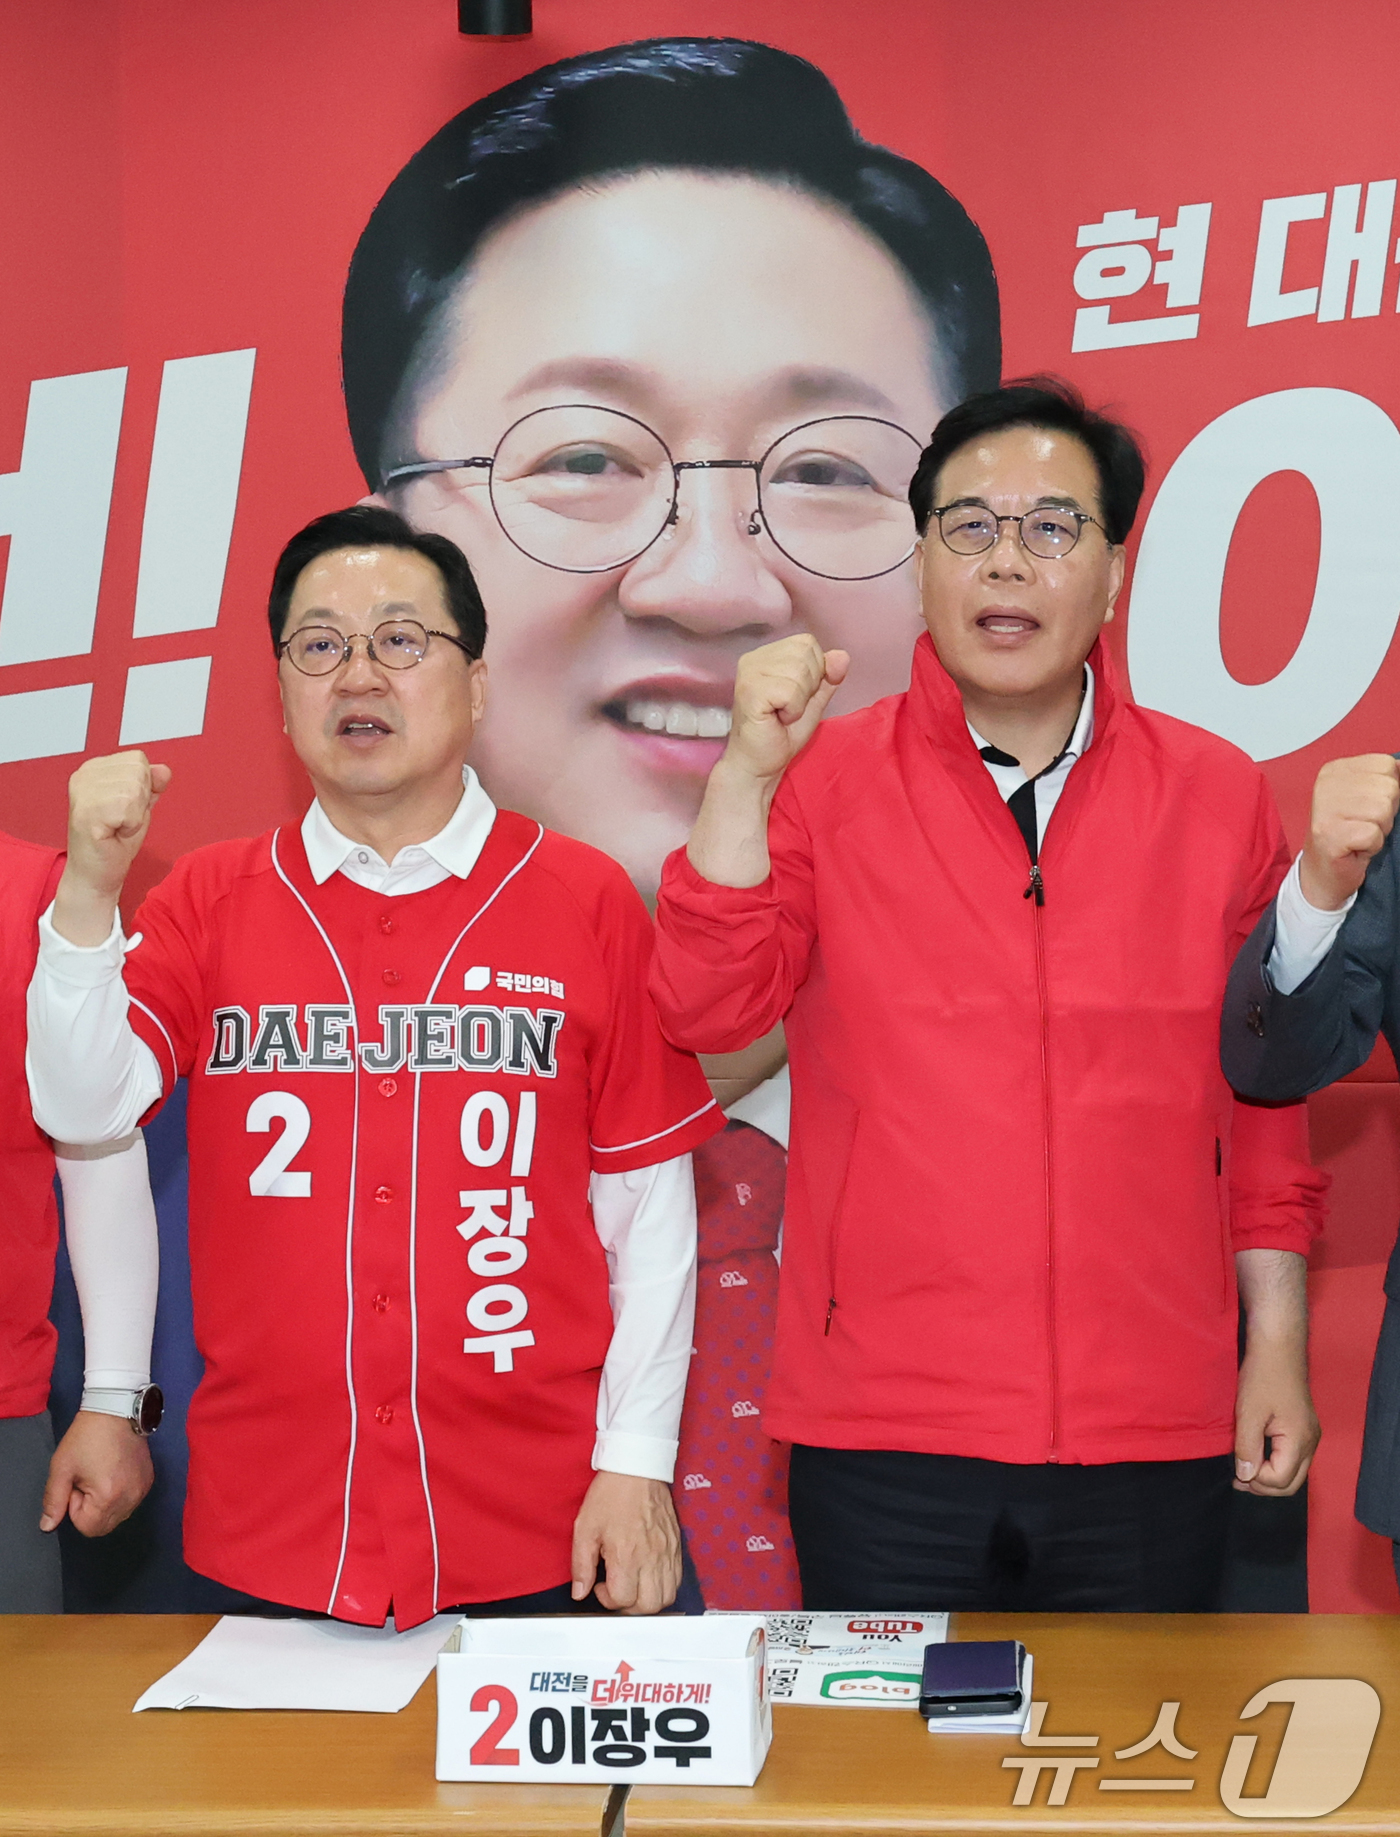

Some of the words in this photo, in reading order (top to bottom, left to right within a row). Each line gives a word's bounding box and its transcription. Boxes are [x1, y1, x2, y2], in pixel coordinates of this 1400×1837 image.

[1071, 202, 1212, 353] 현
[1247, 179, 1400, 327] 대
[495, 971, 565, 1000] 국민의힘
[205, 1003, 565, 1078] DAEJEON
[245, 1090, 312, 1198] 2
[455, 1090, 536, 1374] 이장우
[529, 1671, 589, 1693] 대전을
[838, 1683, 911, 1695] blog
[469, 1684, 520, 1766] 2
[528, 1705, 712, 1768] 이장우
